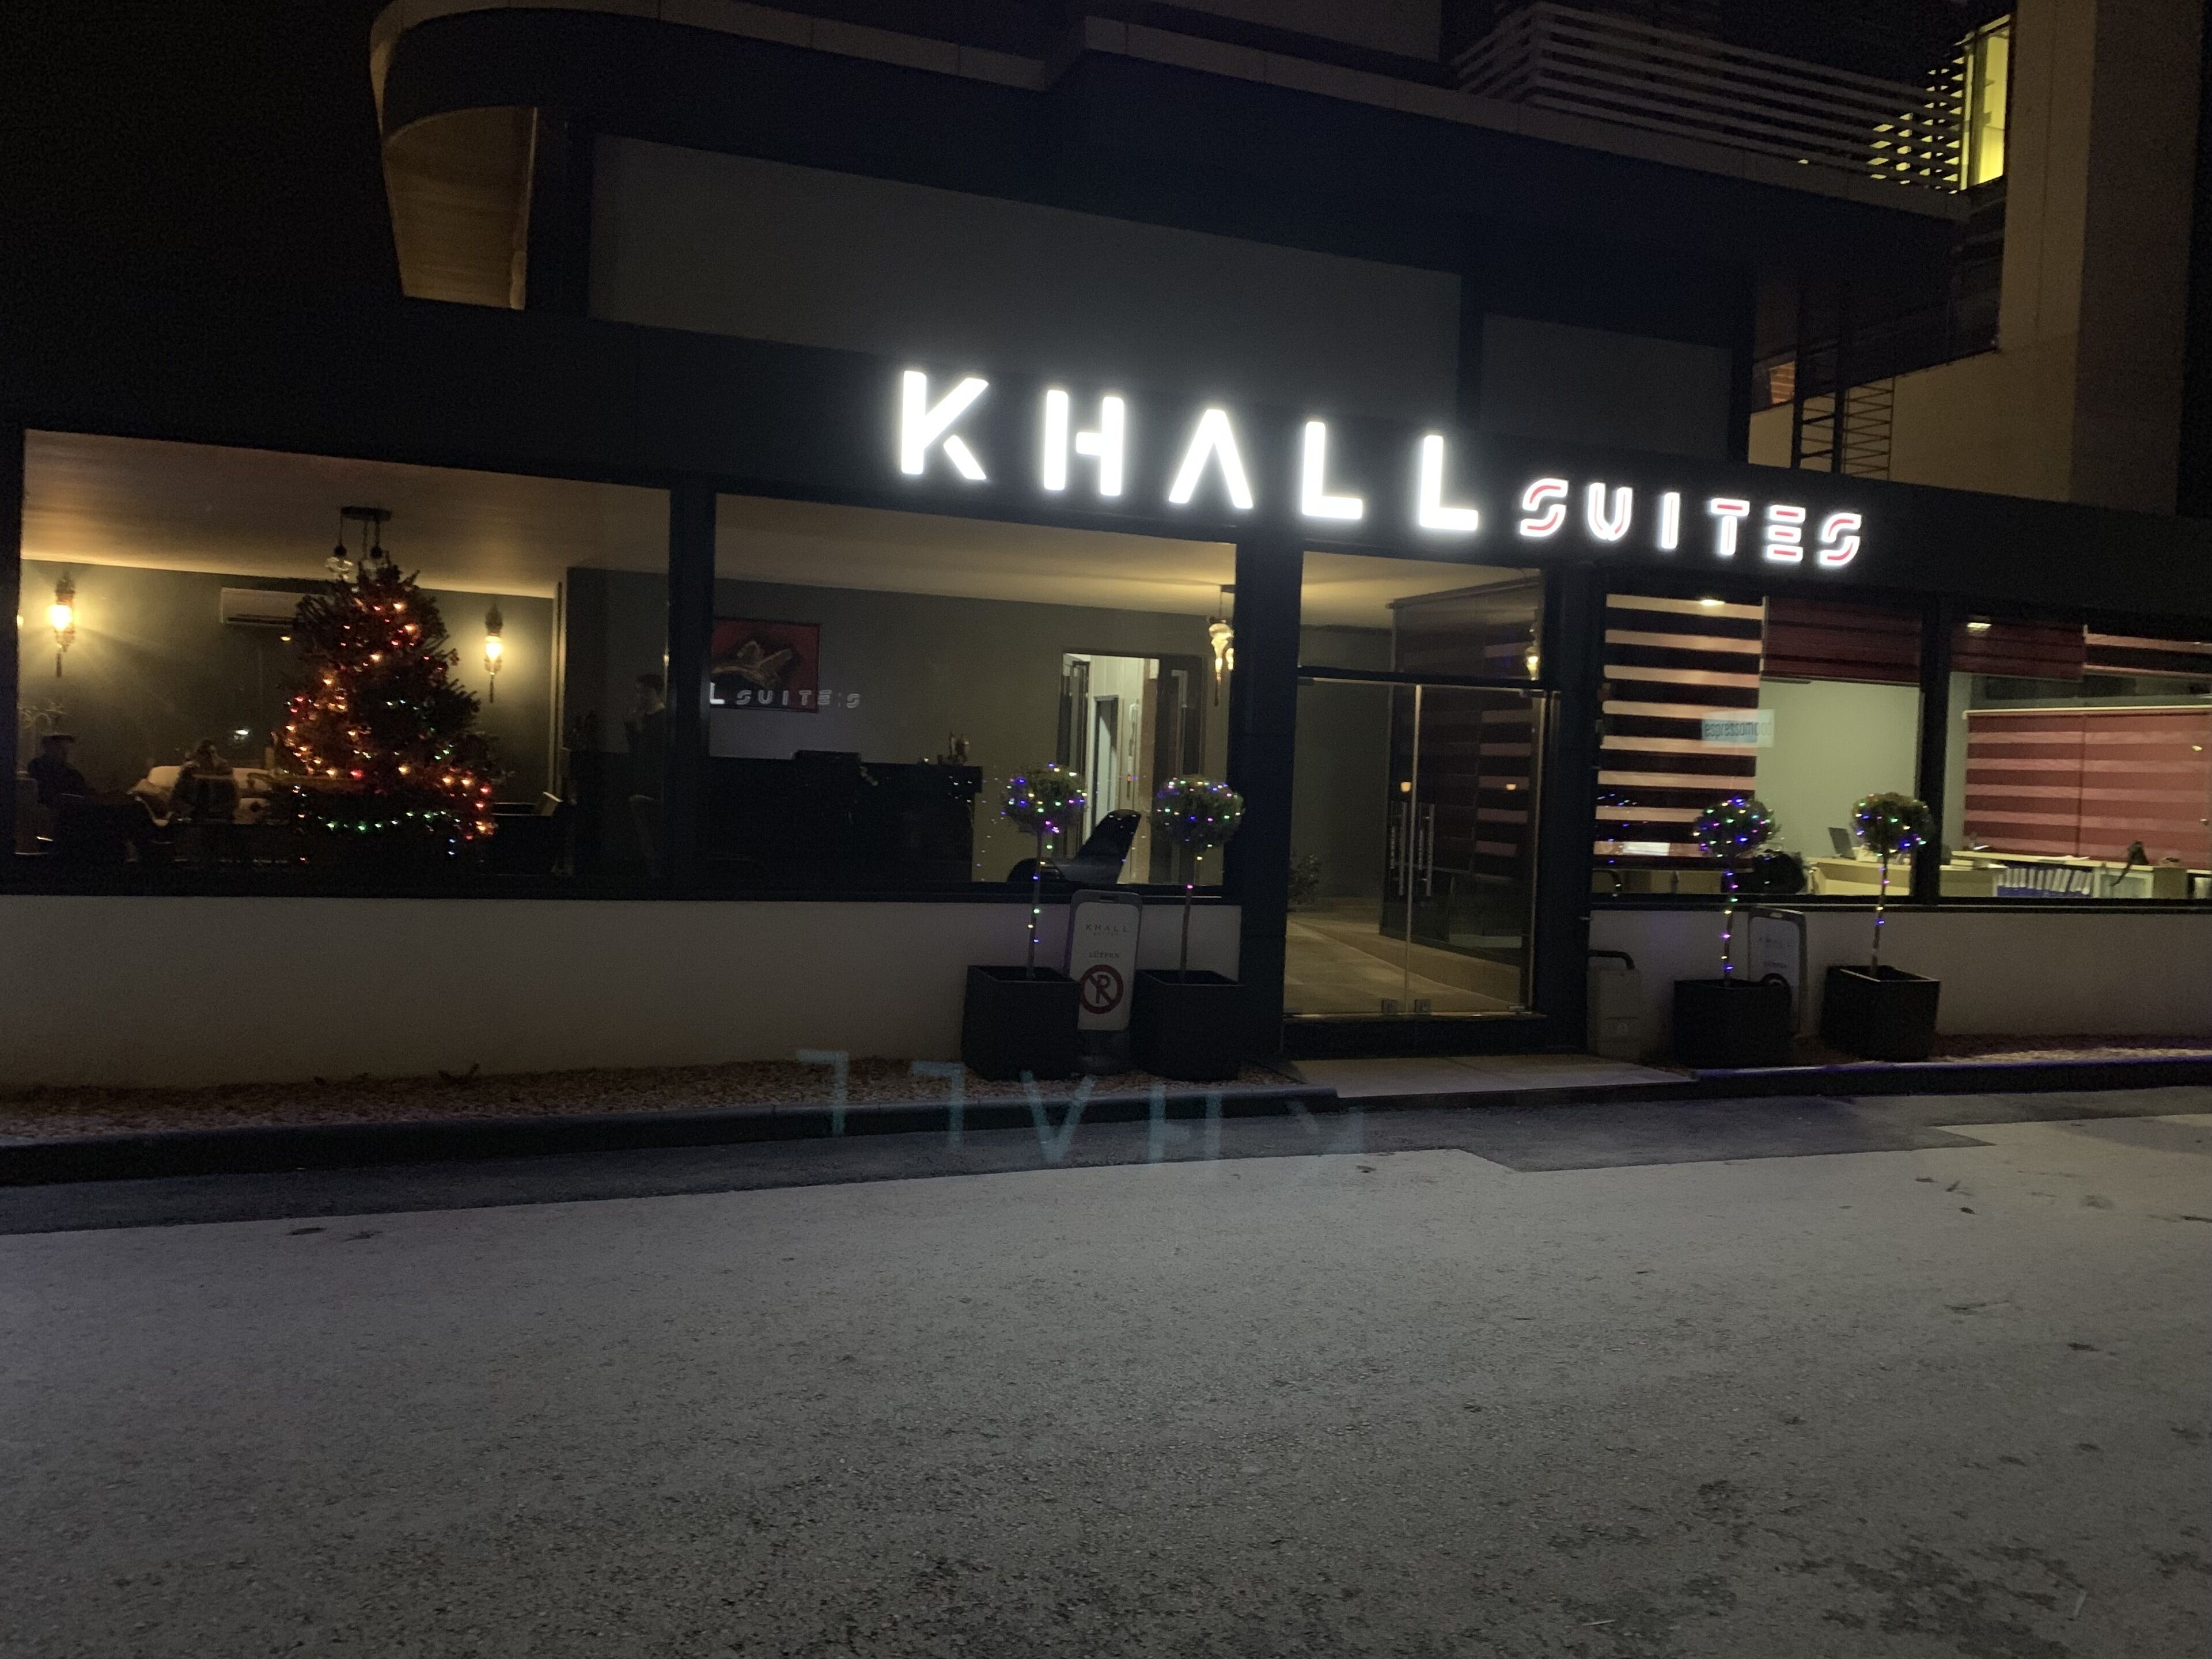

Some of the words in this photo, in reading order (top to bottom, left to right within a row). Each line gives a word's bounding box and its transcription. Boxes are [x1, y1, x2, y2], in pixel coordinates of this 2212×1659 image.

[900, 370, 1479, 531] KHALL
[1519, 478, 1863, 567] SUITES
[1085, 924, 1128, 932] KHALL
